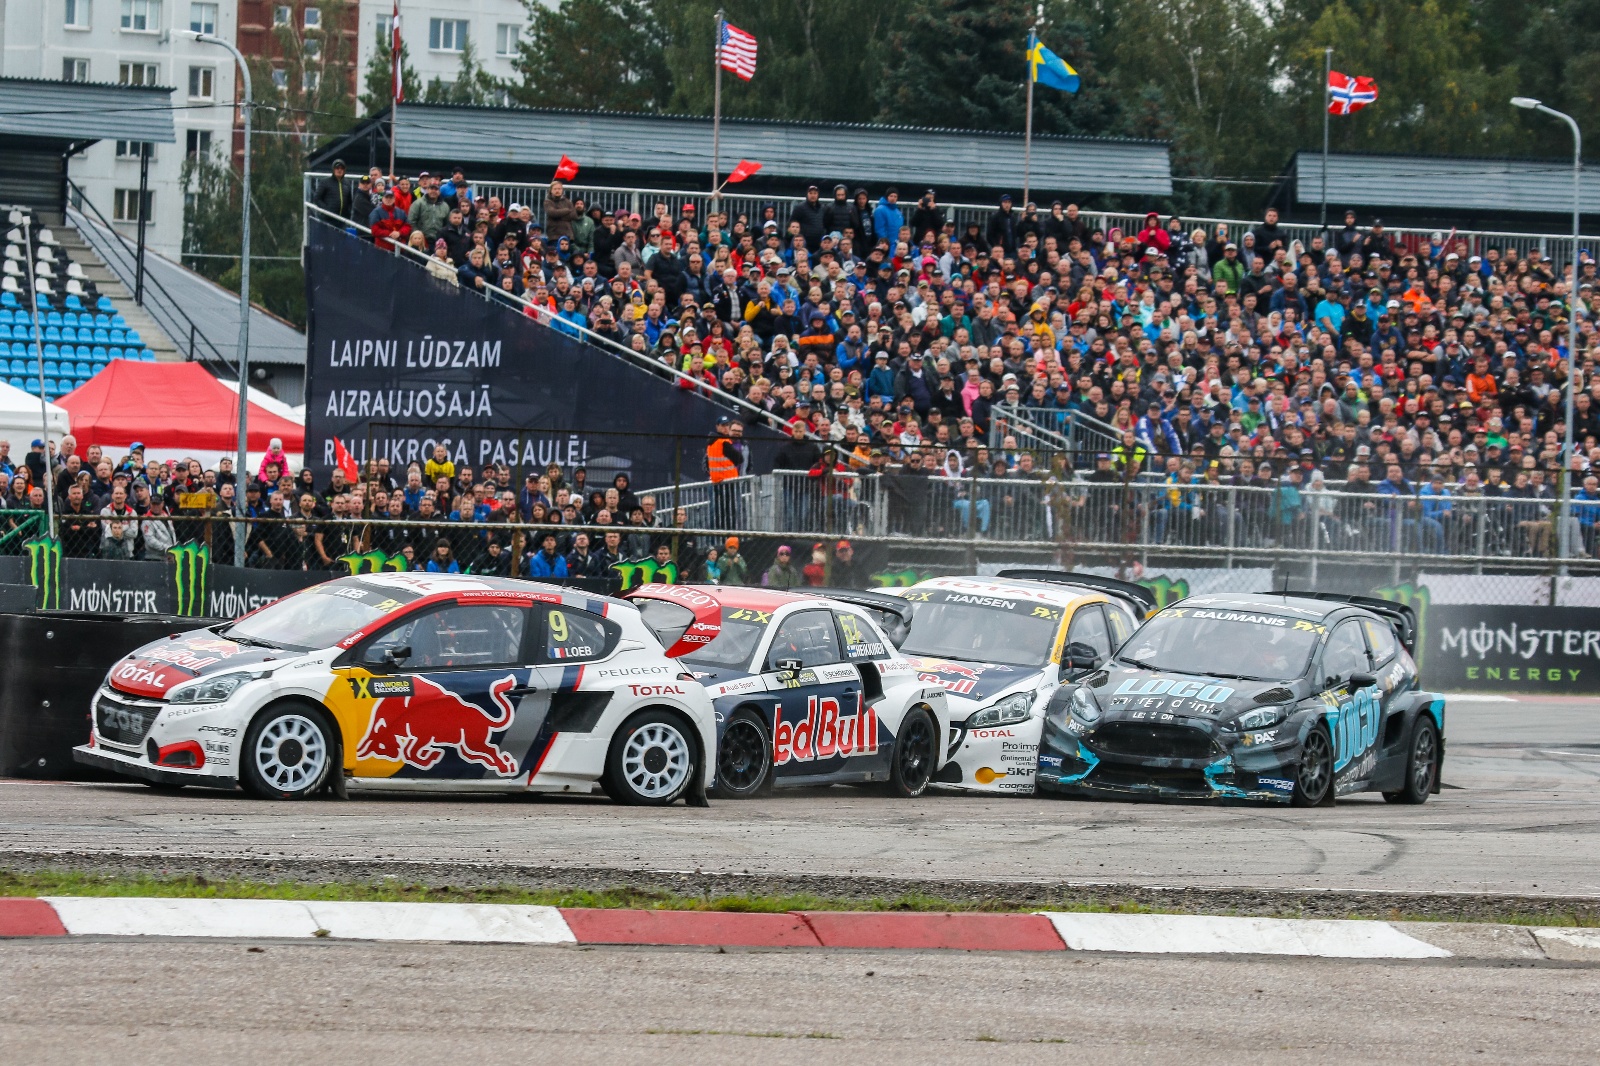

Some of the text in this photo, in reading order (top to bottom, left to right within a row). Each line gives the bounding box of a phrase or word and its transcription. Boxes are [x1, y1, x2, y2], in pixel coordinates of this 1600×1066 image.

[330, 335, 502, 368] LAIPNI LŪDZAM
[325, 383, 493, 417] AIZRAUJOŠAJĀ
[479, 434, 588, 467] PASAULĒ!
[934, 580, 1060, 603] TOTAL
[945, 594, 1017, 610] HANSEN
[548, 610, 569, 642] 9
[1192, 611, 1288, 627] BAUMANIS
[564, 645, 593, 658] LOEB
[115, 662, 166, 688] TOTAL
[598, 666, 669, 678] PEUGEOT
[1466, 666, 1582, 681] ENERGY
[627, 684, 686, 697] TOTAL
[1113, 678, 1236, 704] LOCO
[167, 703, 227, 719] PEUGEOT
[103, 704, 144, 735] 208
[773, 690, 879, 766] ed Bull
[971, 729, 1015, 739] TOTAL
[1007, 767, 1036, 776] SKF
[1258, 778, 1295, 787] COOPER
